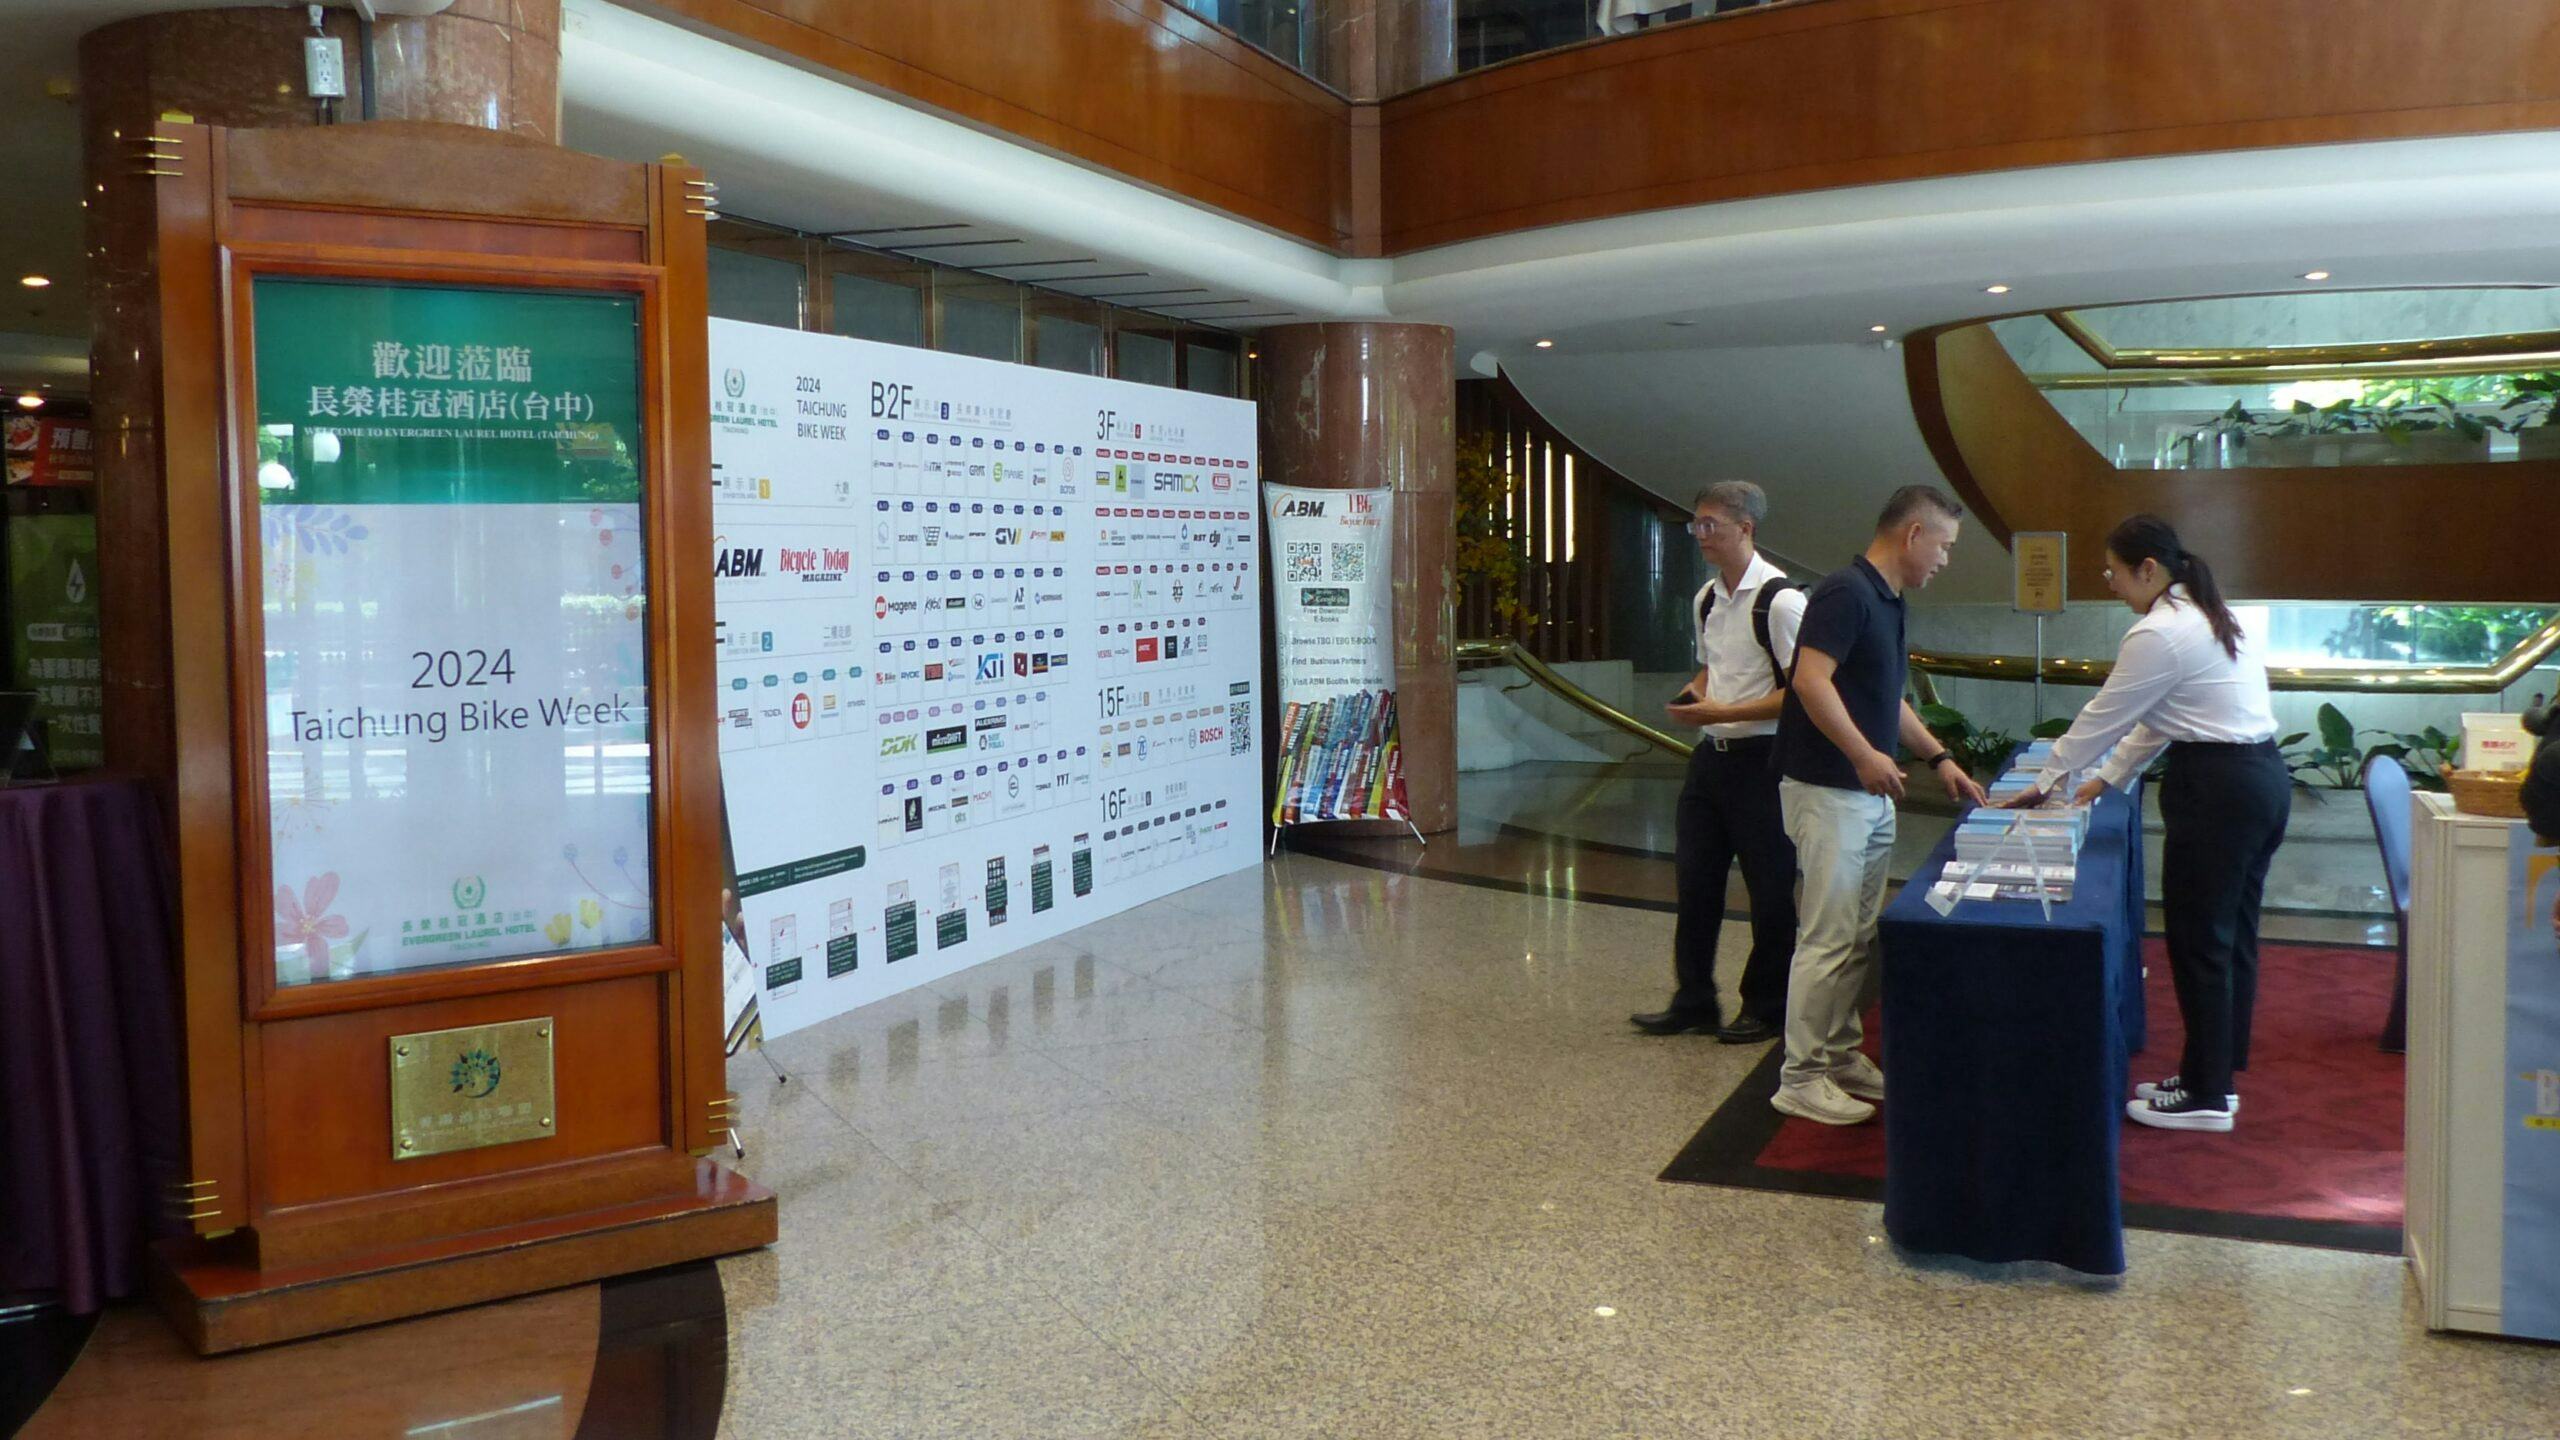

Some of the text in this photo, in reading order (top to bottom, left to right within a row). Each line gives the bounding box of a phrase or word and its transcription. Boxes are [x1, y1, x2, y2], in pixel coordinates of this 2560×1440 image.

[372, 342, 532, 383] 歡迎蒞臨
[796, 376, 821, 393] 2024
[308, 385, 594, 421] 長榮桂冠酒店(台中)
[796, 400, 847, 418] TAICHUNG
[871, 381, 913, 420] B2F
[365, 427, 383, 438] TO
[384, 427, 452, 439] EVERGREEN
[455, 429, 499, 440] LAUREL
[500, 430, 535, 440] HOTEL
[797, 423, 847, 441] BIKE WEEK
[1096, 409, 1116, 441] 3F
[1282, 501, 1325, 518] ABM
[714, 548, 850, 578] ABM Bicycle Today
[802, 573, 843, 583] MAGAZINE
[412, 649, 515, 689] 2024
[1310, 657, 1340, 665] Business
[1098, 685, 1125, 719] 15F
[290, 694, 631, 743] Taichung Bike Week
[1199, 726, 1224, 744] BOSCH
[1100, 788, 1127, 823] 16F
